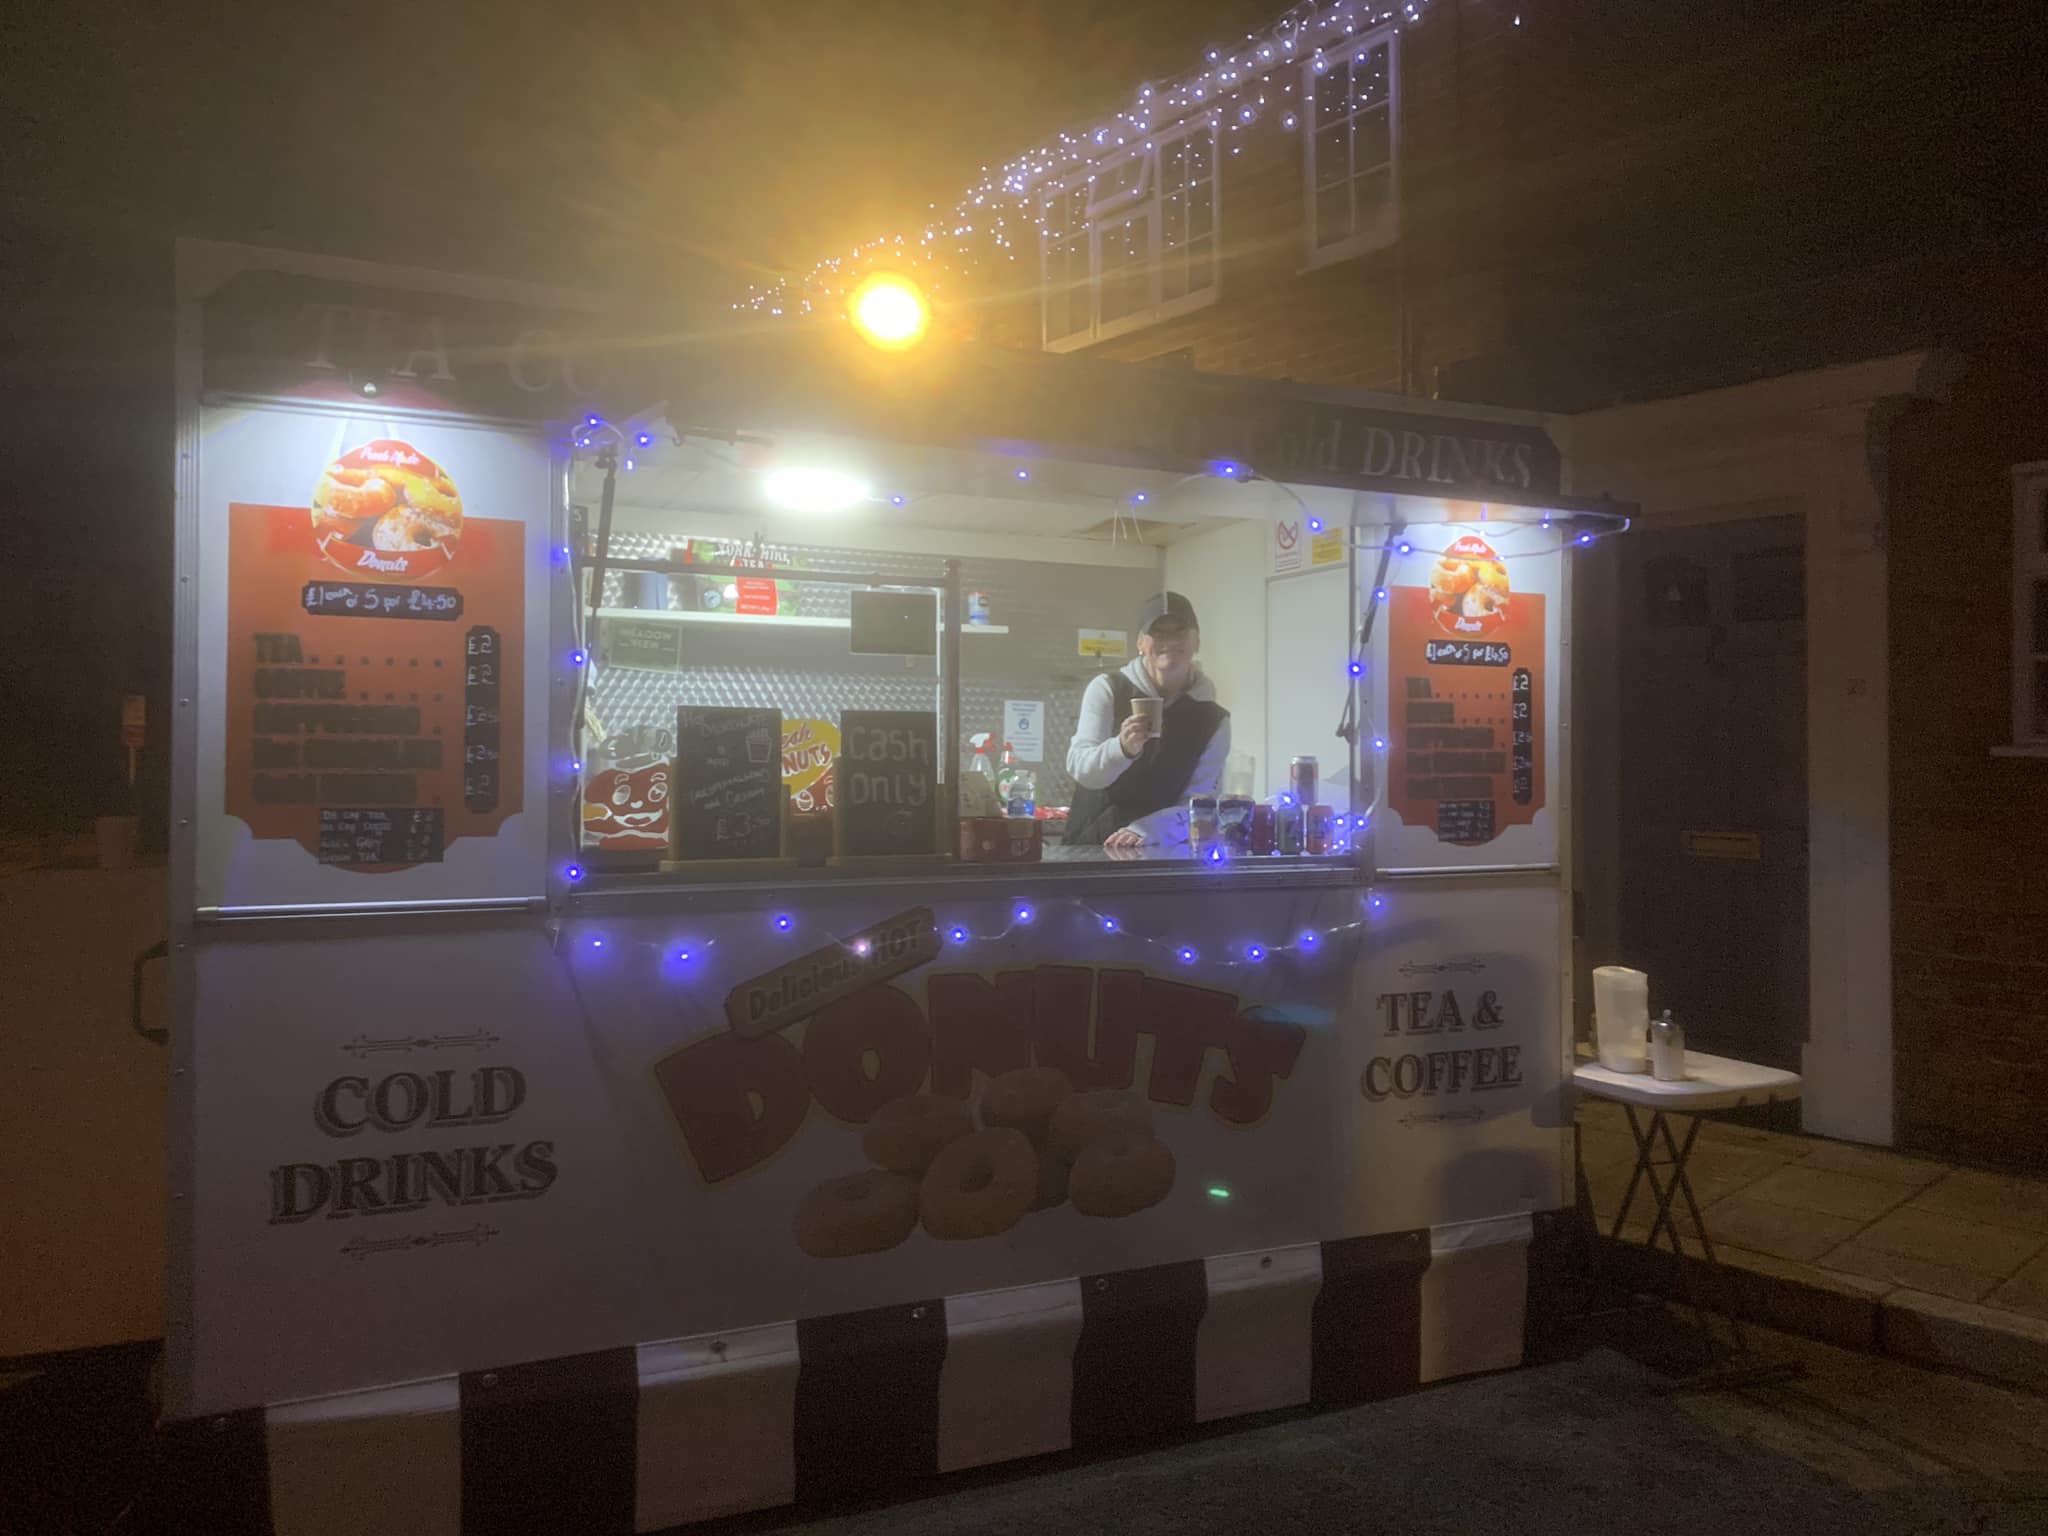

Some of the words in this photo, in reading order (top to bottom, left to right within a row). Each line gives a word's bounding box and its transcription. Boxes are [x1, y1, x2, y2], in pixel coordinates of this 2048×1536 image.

[302, 301, 457, 383] TA
[1359, 425, 1533, 490] DRINKS
[356, 549, 408, 572] Donuts
[364, 588, 379, 610] 5
[467, 633, 493, 656] £2
[467, 663, 496, 686] £2
[1512, 674, 1529, 691] £2
[1512, 702, 1528, 719] £2
[781, 743, 833, 777] NUTS
[850, 726, 932, 767] Cash
[850, 770, 928, 807] Only
[750, 953, 866, 1022] Delicious
[1375, 988, 1465, 1038] TEA
[1471, 989, 1505, 1031] &
[653, 963, 1307, 1185] DONUTS
[1360, 1044, 1524, 1103] COFFEE
[313, 1064, 528, 1138] COLD
[266, 1140, 559, 1226] DRINKS
